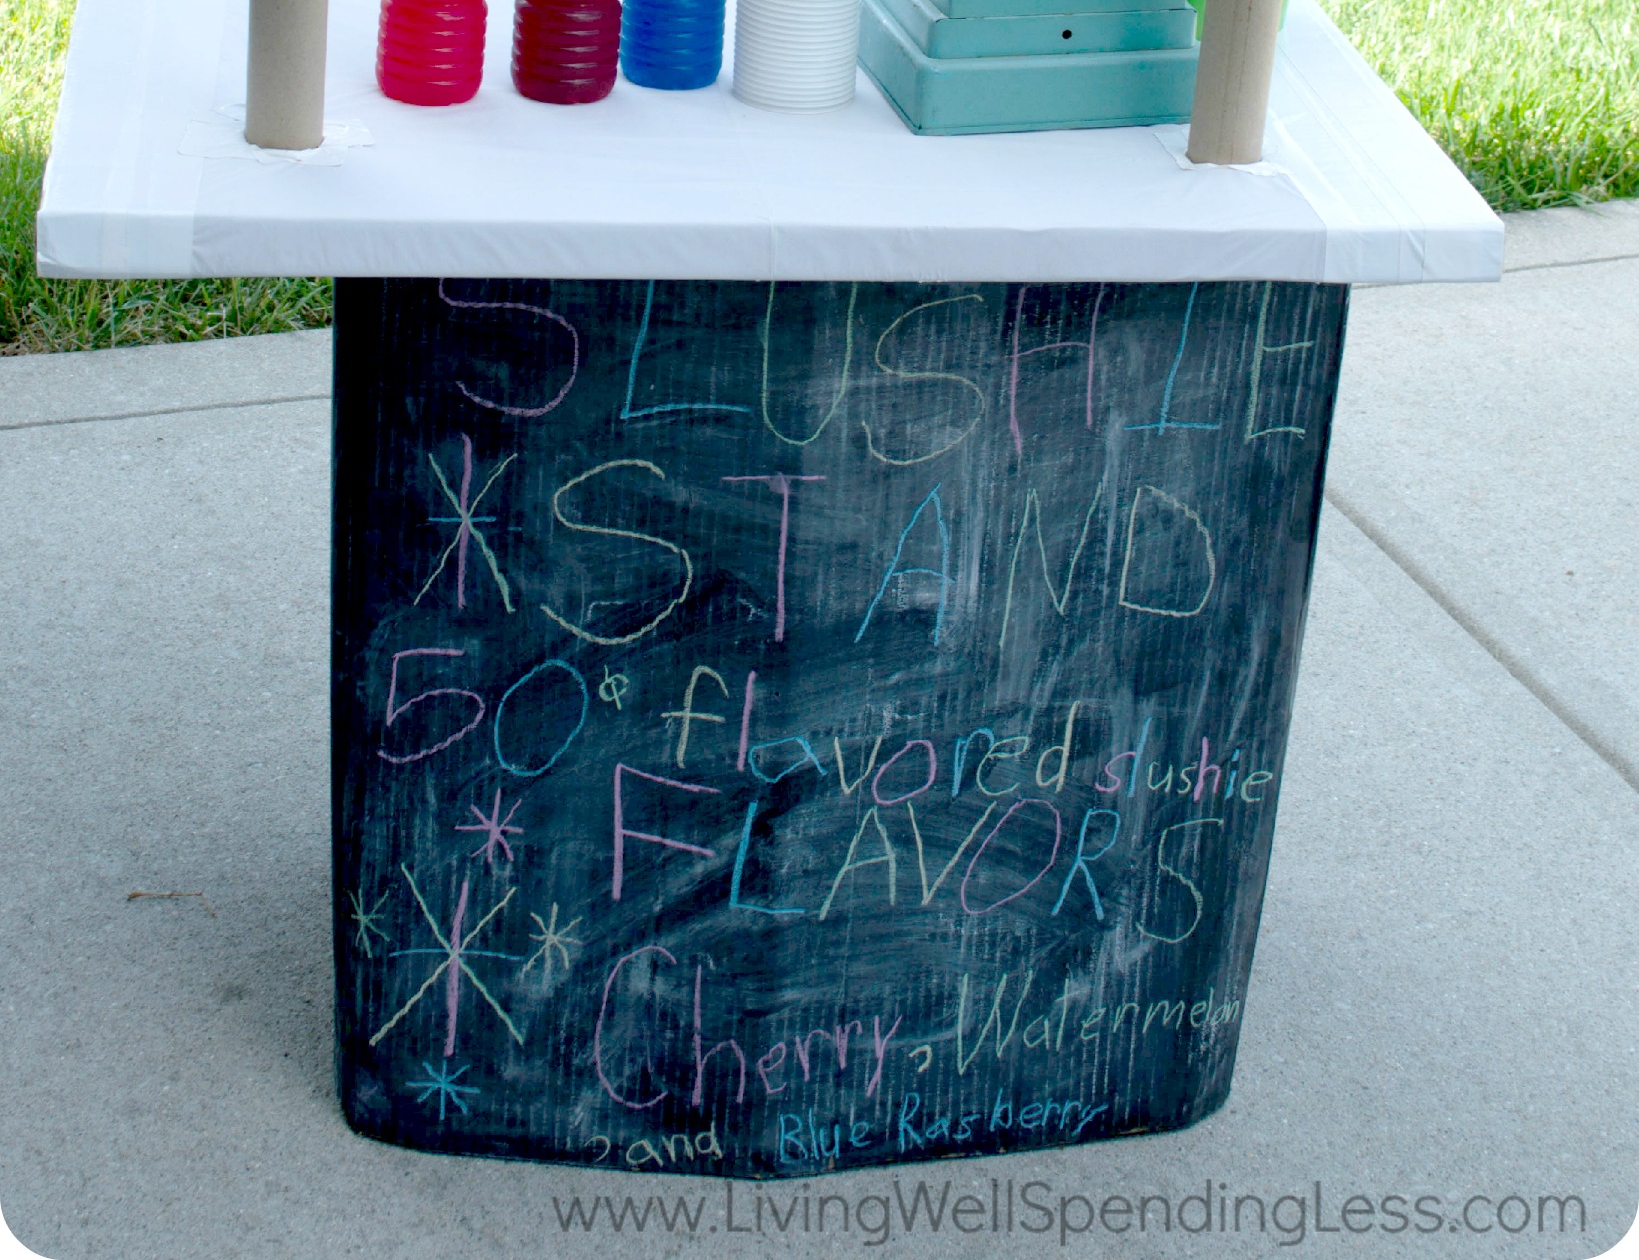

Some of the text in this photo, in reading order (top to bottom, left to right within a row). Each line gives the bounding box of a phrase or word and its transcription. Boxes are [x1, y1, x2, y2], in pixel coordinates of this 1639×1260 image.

[540, 458, 1215, 647] STAND
[661, 665, 1081, 806] flavored
[1096, 716, 1274, 804] slushie
[612, 762, 1225, 944] FLAVORS
[957, 969, 1241, 1076] Watermelon
[625, 1123, 723, 1167] and
[777, 1108, 871, 1163] Blue
